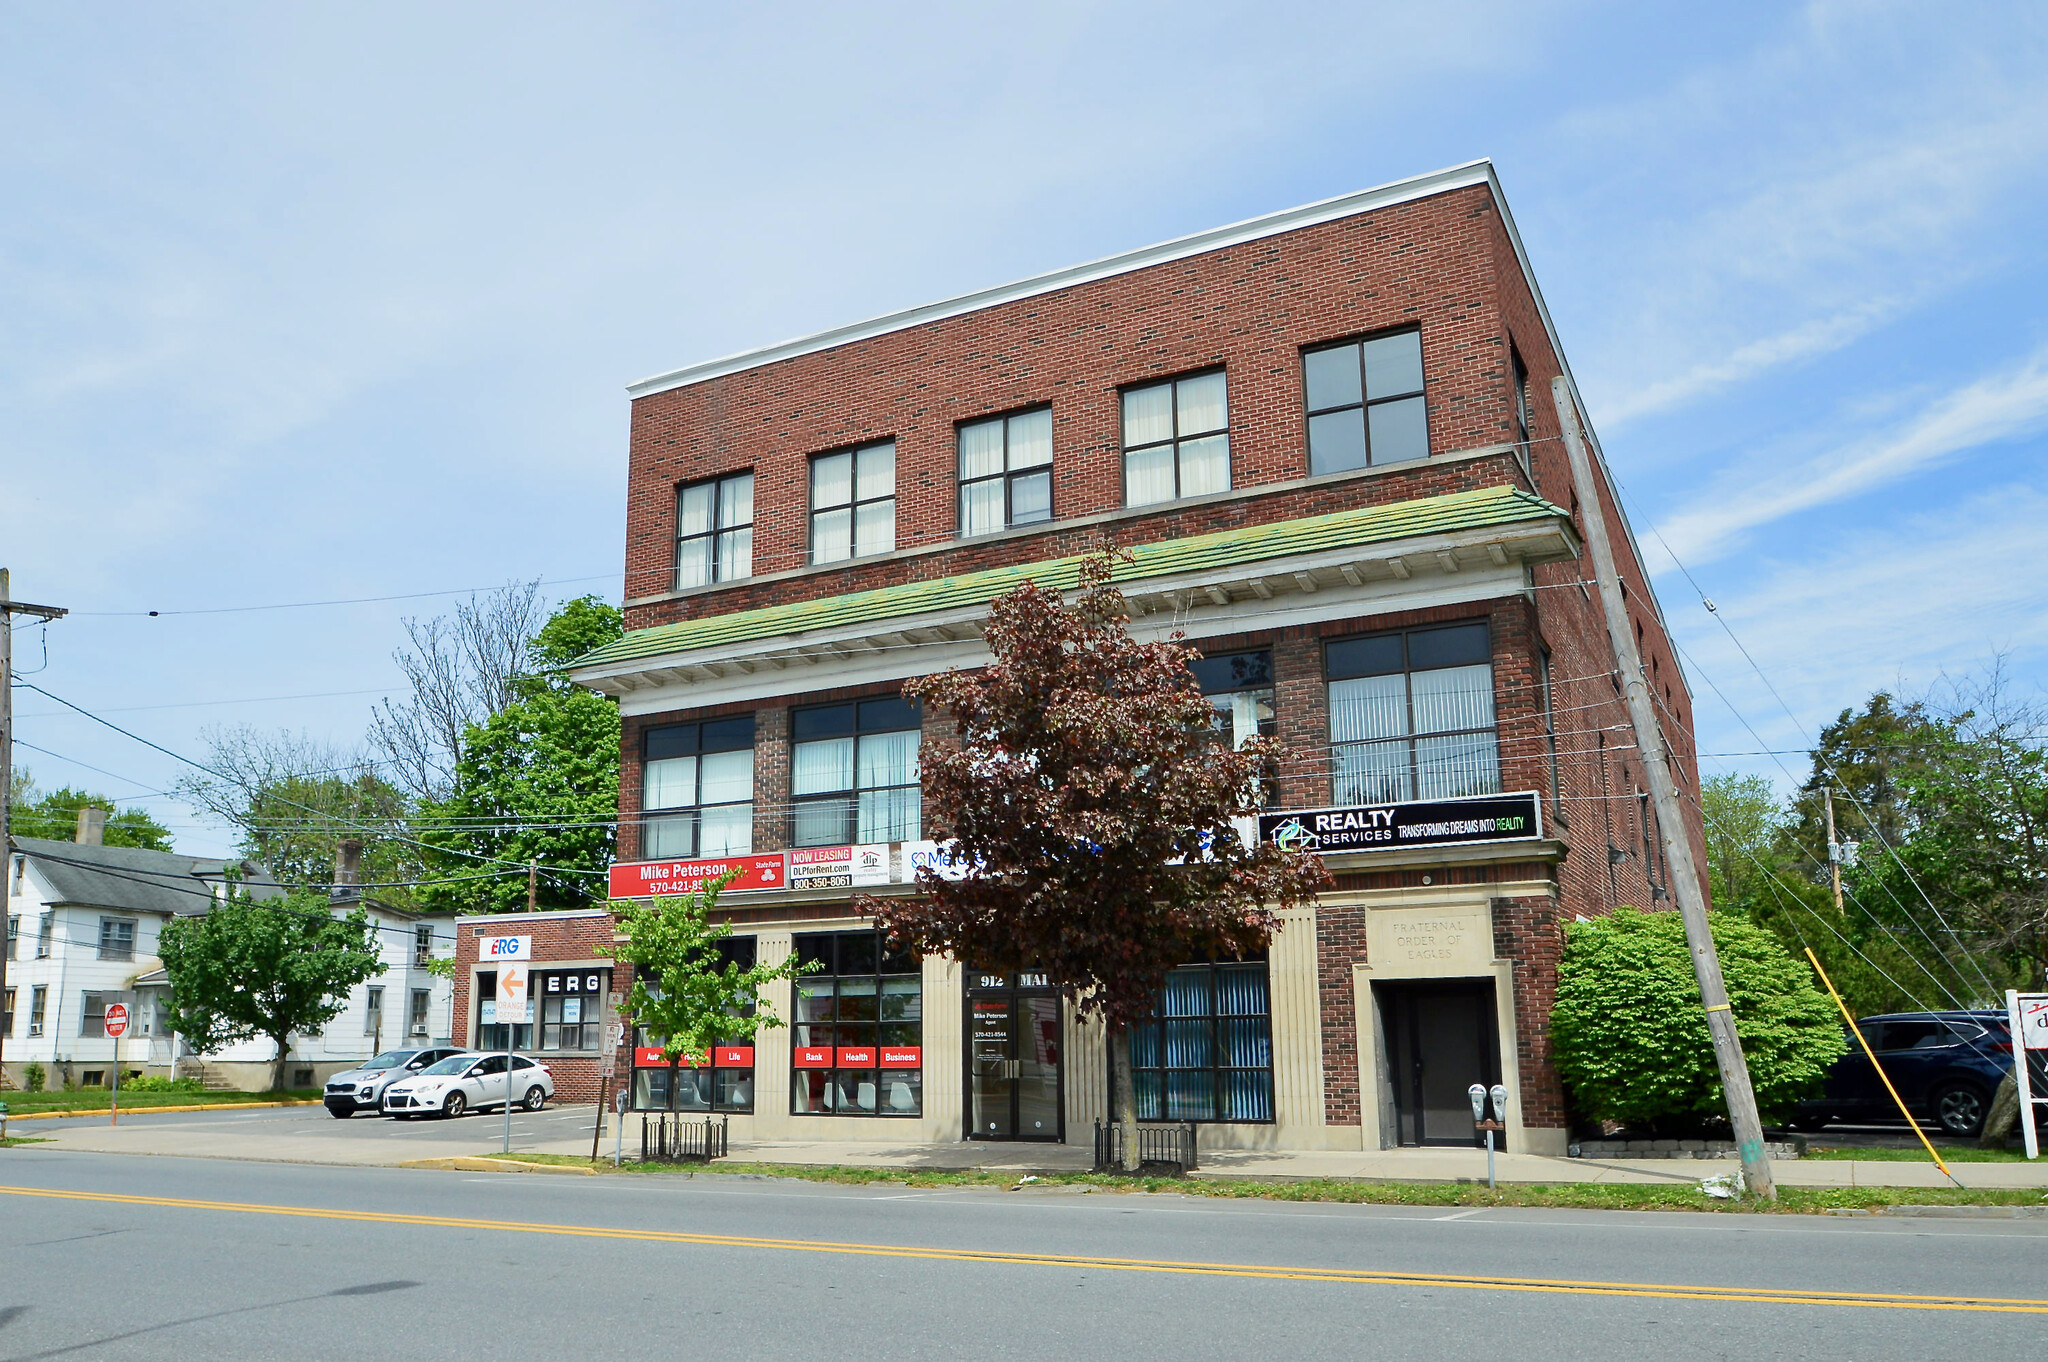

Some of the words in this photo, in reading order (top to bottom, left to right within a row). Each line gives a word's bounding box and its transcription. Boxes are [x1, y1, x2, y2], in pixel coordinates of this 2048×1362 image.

[1316, 809, 1395, 832] REALTY
[1398, 820, 1450, 839] TRANSFORMING
[1450, 820, 1479, 835] DREAMS
[1479, 818, 1496, 832] INTO
[1496, 816, 1524, 831] REALITY
[1322, 829, 1392, 845] SERVICES
[793, 851, 812, 864] NOW
[814, 849, 849, 860] LEASING
[863, 855, 878, 866] dlp
[640, 866, 669, 880] Mike
[672, 863, 727, 878] Peterson
[793, 864, 850, 876] DLPforRent.com
[794, 876, 850, 889] 800-350-8061
[1393, 921, 1465, 932] FRATERNAL
[490, 938, 519, 955] ERG
[1397, 936, 1435, 946] ORDER
[1447, 935, 1461, 945] OF
[1408, 949, 1452, 960] EAGLES
[980, 975, 1005, 987] 912
[728, 1052, 741, 1060] Life
[805, 1053, 823, 1061] Bank
[845, 1052, 868, 1061] Health
[885, 1052, 916, 1061] Business
